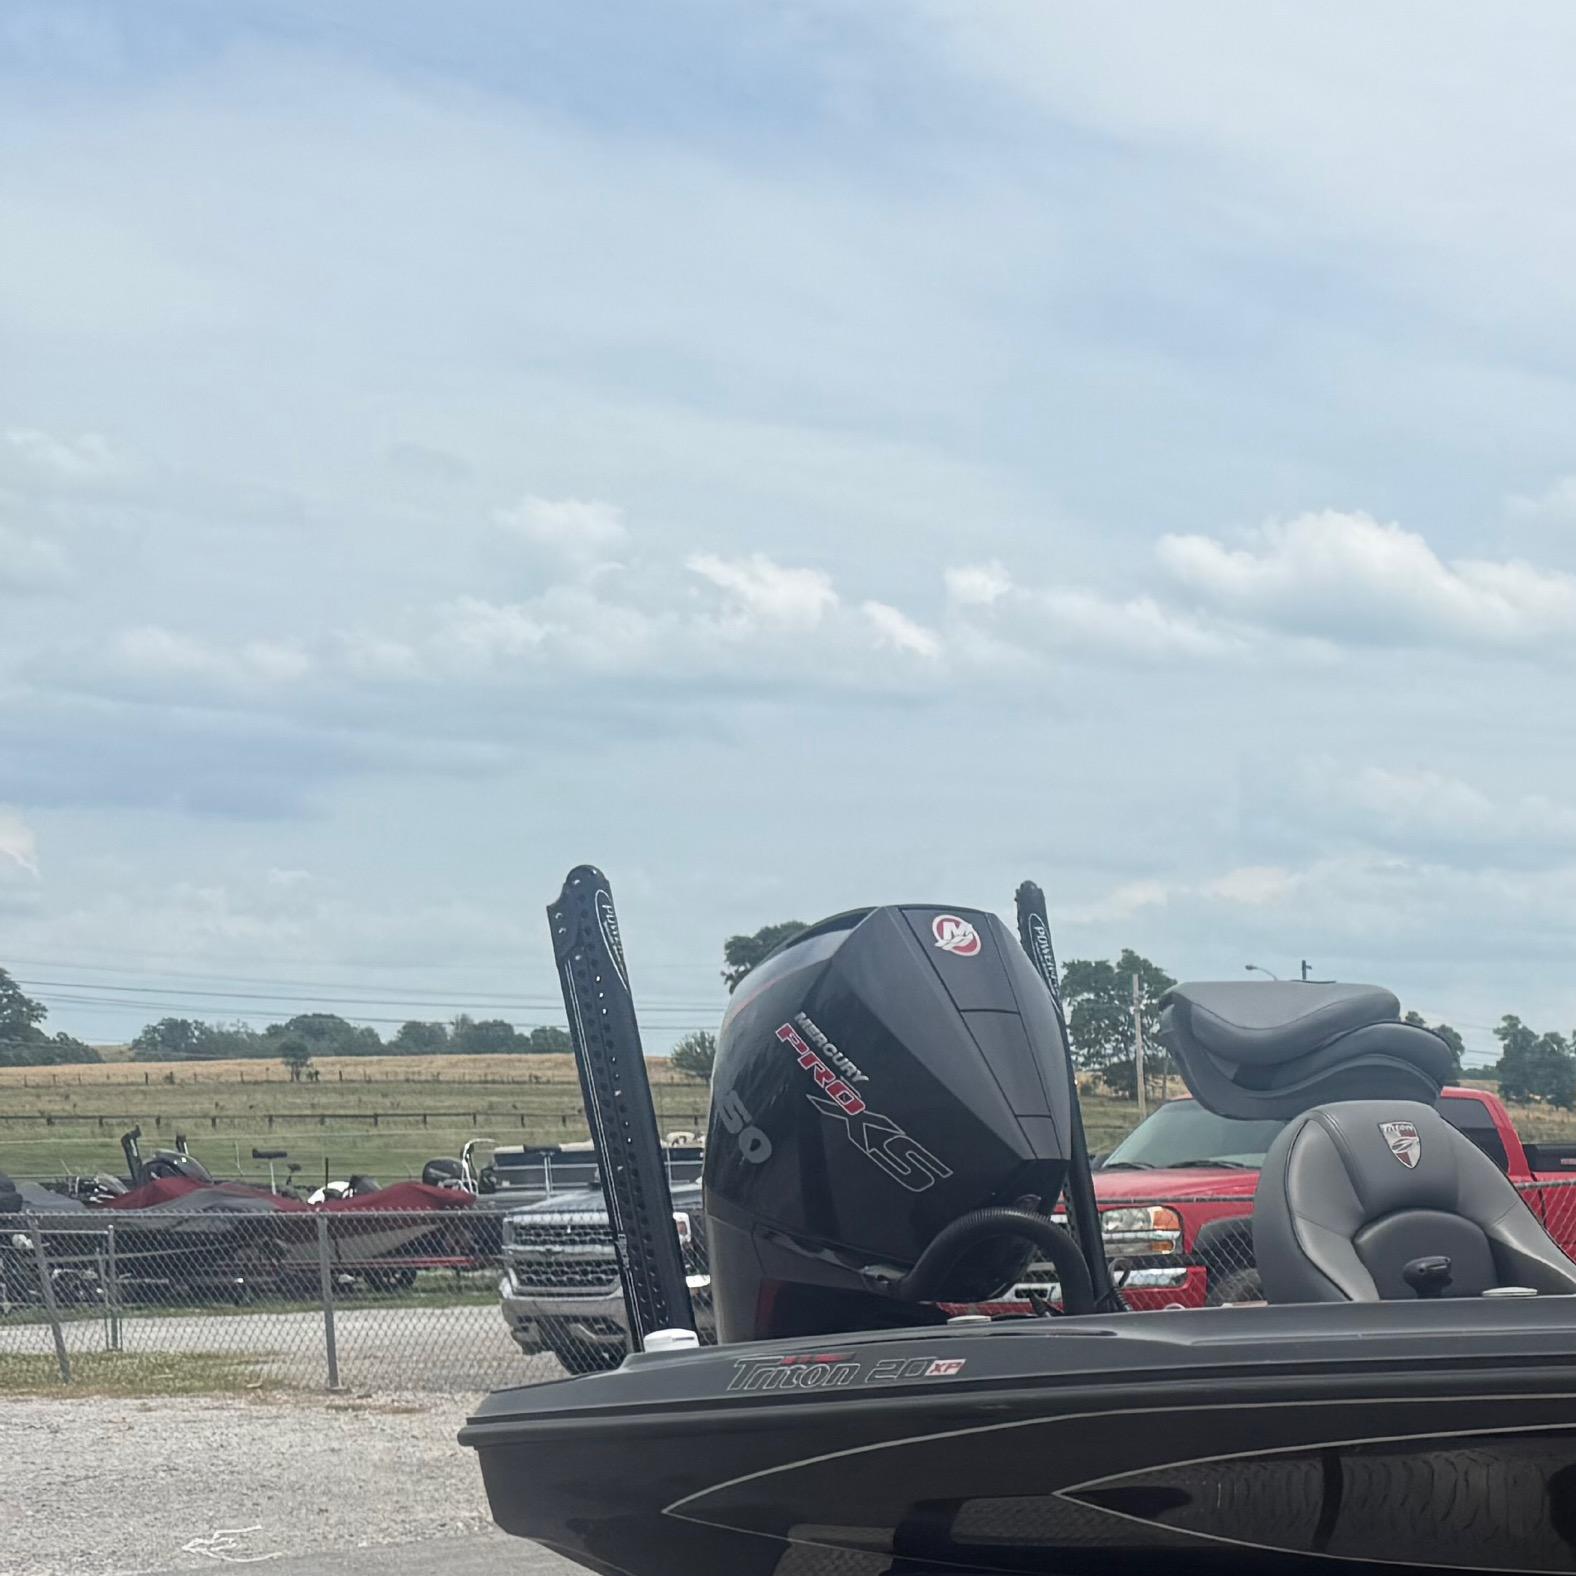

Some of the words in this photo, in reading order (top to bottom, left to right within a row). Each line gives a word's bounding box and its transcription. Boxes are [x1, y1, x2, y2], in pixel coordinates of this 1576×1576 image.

[775, 1022, 866, 1116] PRO
[795, 1011, 870, 1083] MERCURY
[806, 1093, 954, 1193] XS
[727, 1355, 861, 1391] Triton
[865, 1356, 937, 1383] 20
